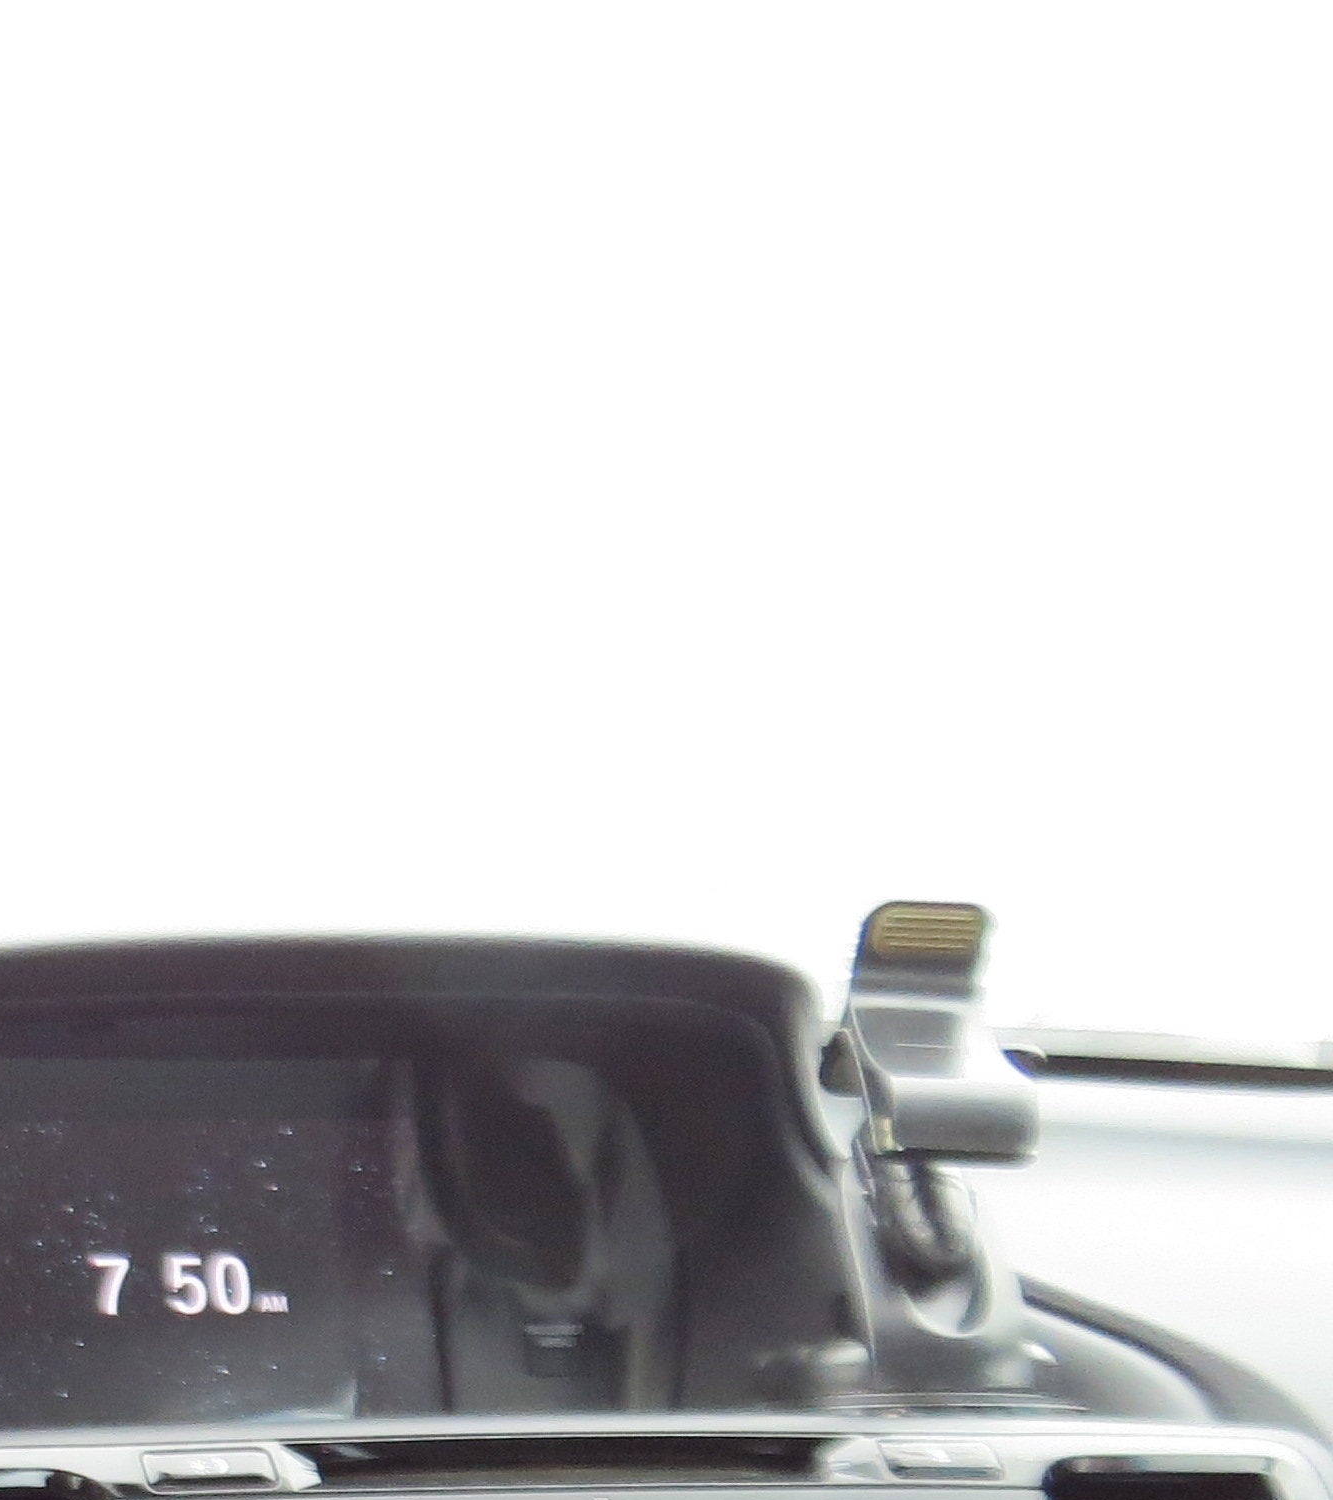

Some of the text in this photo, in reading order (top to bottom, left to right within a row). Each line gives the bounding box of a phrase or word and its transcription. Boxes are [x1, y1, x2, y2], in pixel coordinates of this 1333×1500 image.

[89, 1252, 290, 1316] 7 50 AM
